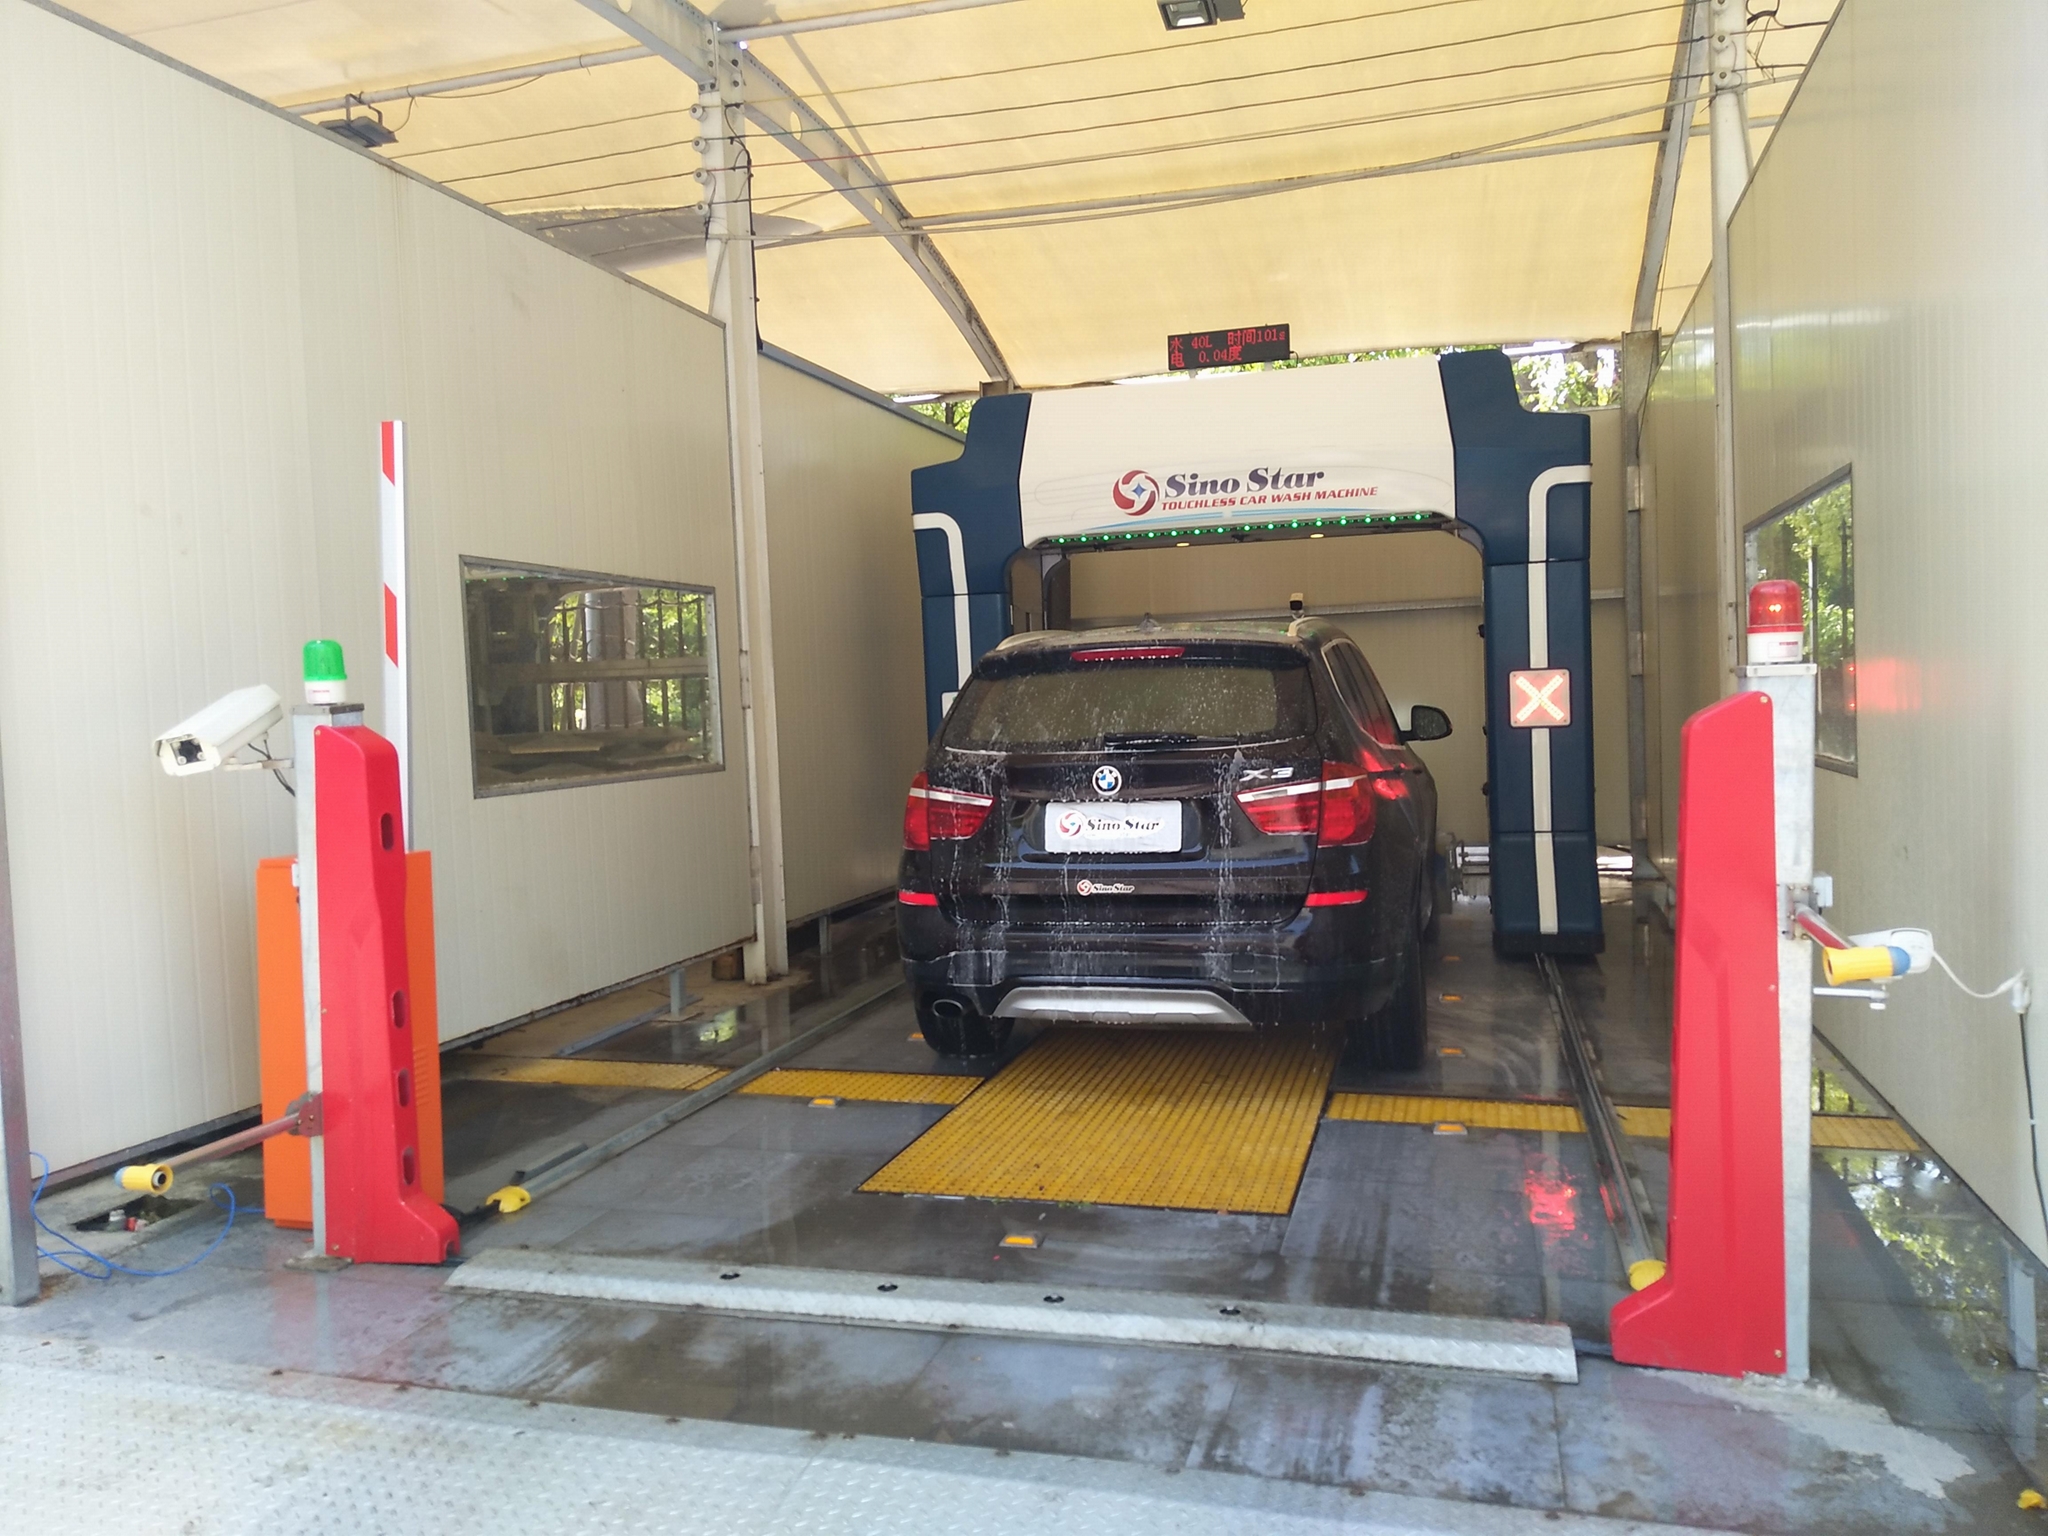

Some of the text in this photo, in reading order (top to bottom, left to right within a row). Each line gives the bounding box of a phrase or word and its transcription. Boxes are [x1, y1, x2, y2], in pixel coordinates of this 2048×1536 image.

[1170, 337, 1184, 352] 水
[1191, 335, 1212, 349] 40L
[1171, 351, 1185, 368] 电
[1164, 466, 1325, 498] Sino Star
[1161, 486, 1378, 511] TOUCHLESS CAR WASH MACHINE
[1239, 767, 1294, 782] X3
[1085, 818, 1160, 831] Sino Star
